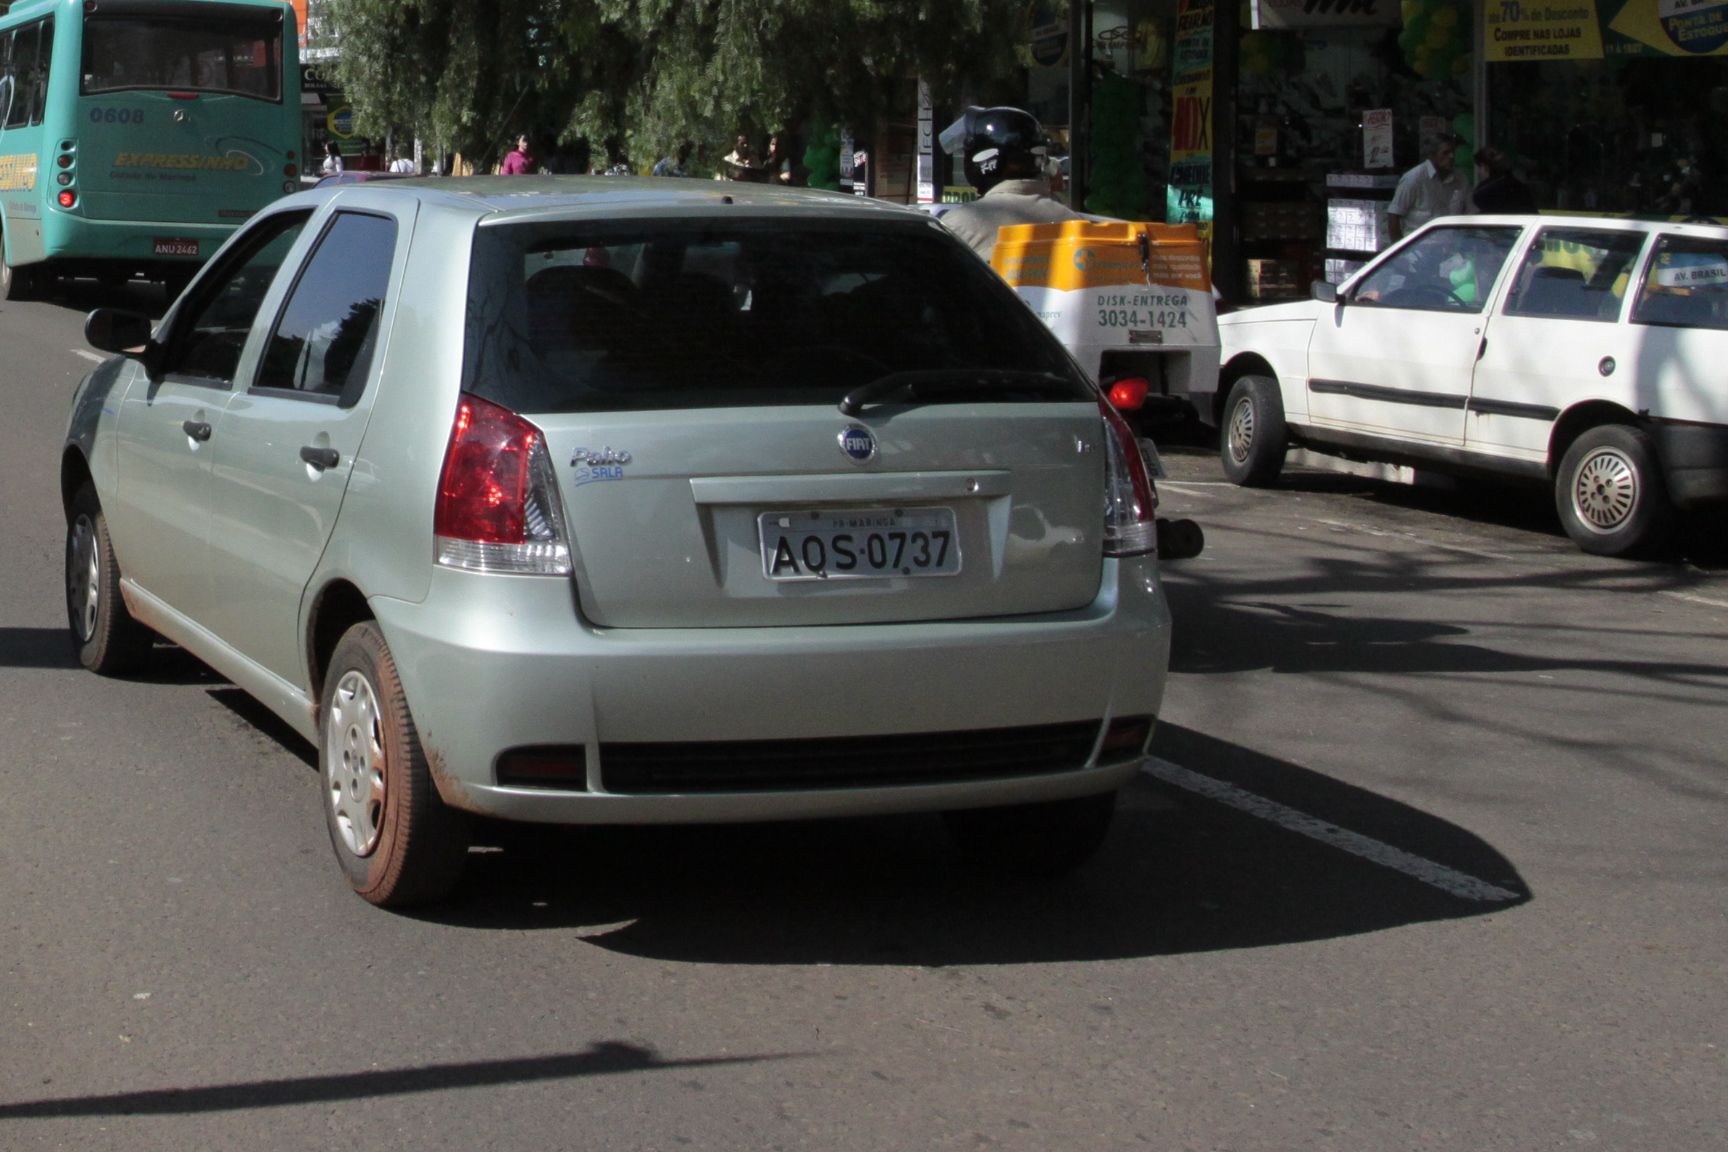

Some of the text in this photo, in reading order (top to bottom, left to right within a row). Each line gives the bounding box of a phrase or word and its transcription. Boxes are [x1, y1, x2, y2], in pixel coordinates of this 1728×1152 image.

[90, 107, 144, 124] 0608
[1691, 269, 1727, 280] BRASIL
[1097, 294, 1188, 307] DISK-ENTREGA
[1098, 309, 1187, 329] 3034-1424
[845, 436, 872, 451] FIAT
[569, 445, 633, 468] Palio
